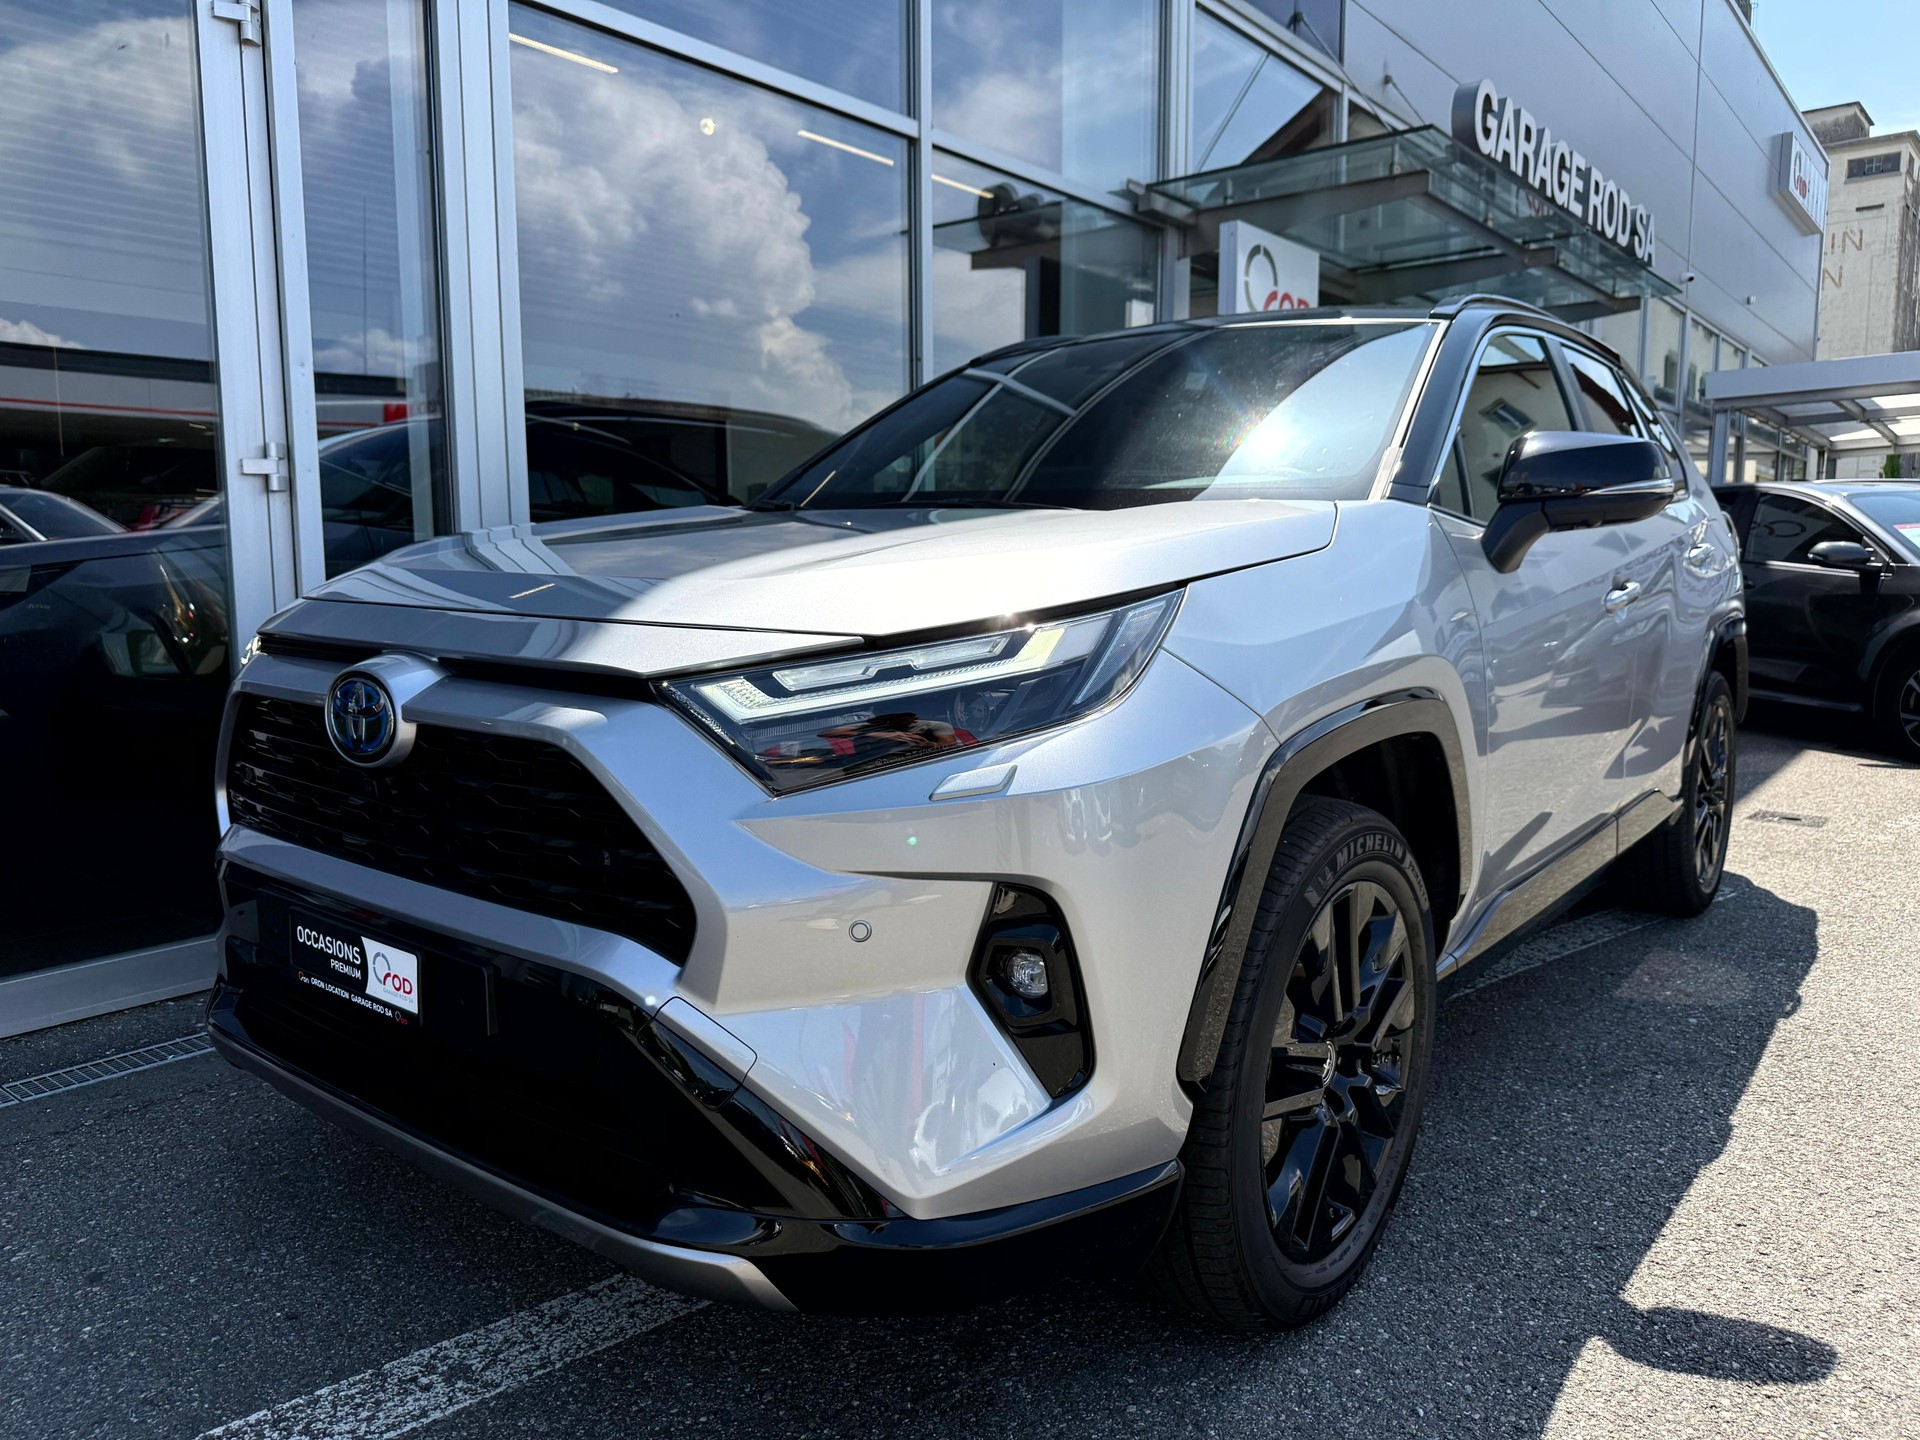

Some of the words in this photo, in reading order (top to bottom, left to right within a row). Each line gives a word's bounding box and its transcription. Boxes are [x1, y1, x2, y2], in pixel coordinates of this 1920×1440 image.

[1474, 78, 1586, 219] GARAGE
[1587, 165, 1632, 248] ROD
[1633, 202, 1656, 268] SA
[1336, 833, 1405, 872] MICHELIN
[297, 926, 362, 965] OCCASIONS
[330, 958, 362, 980] PREMIUM
[325, 983, 350, 999] LOCATION
[351, 994, 373, 1010] GARAGE
[372, 1002, 385, 1014] ROD
[385, 1007, 393, 1018] SA
